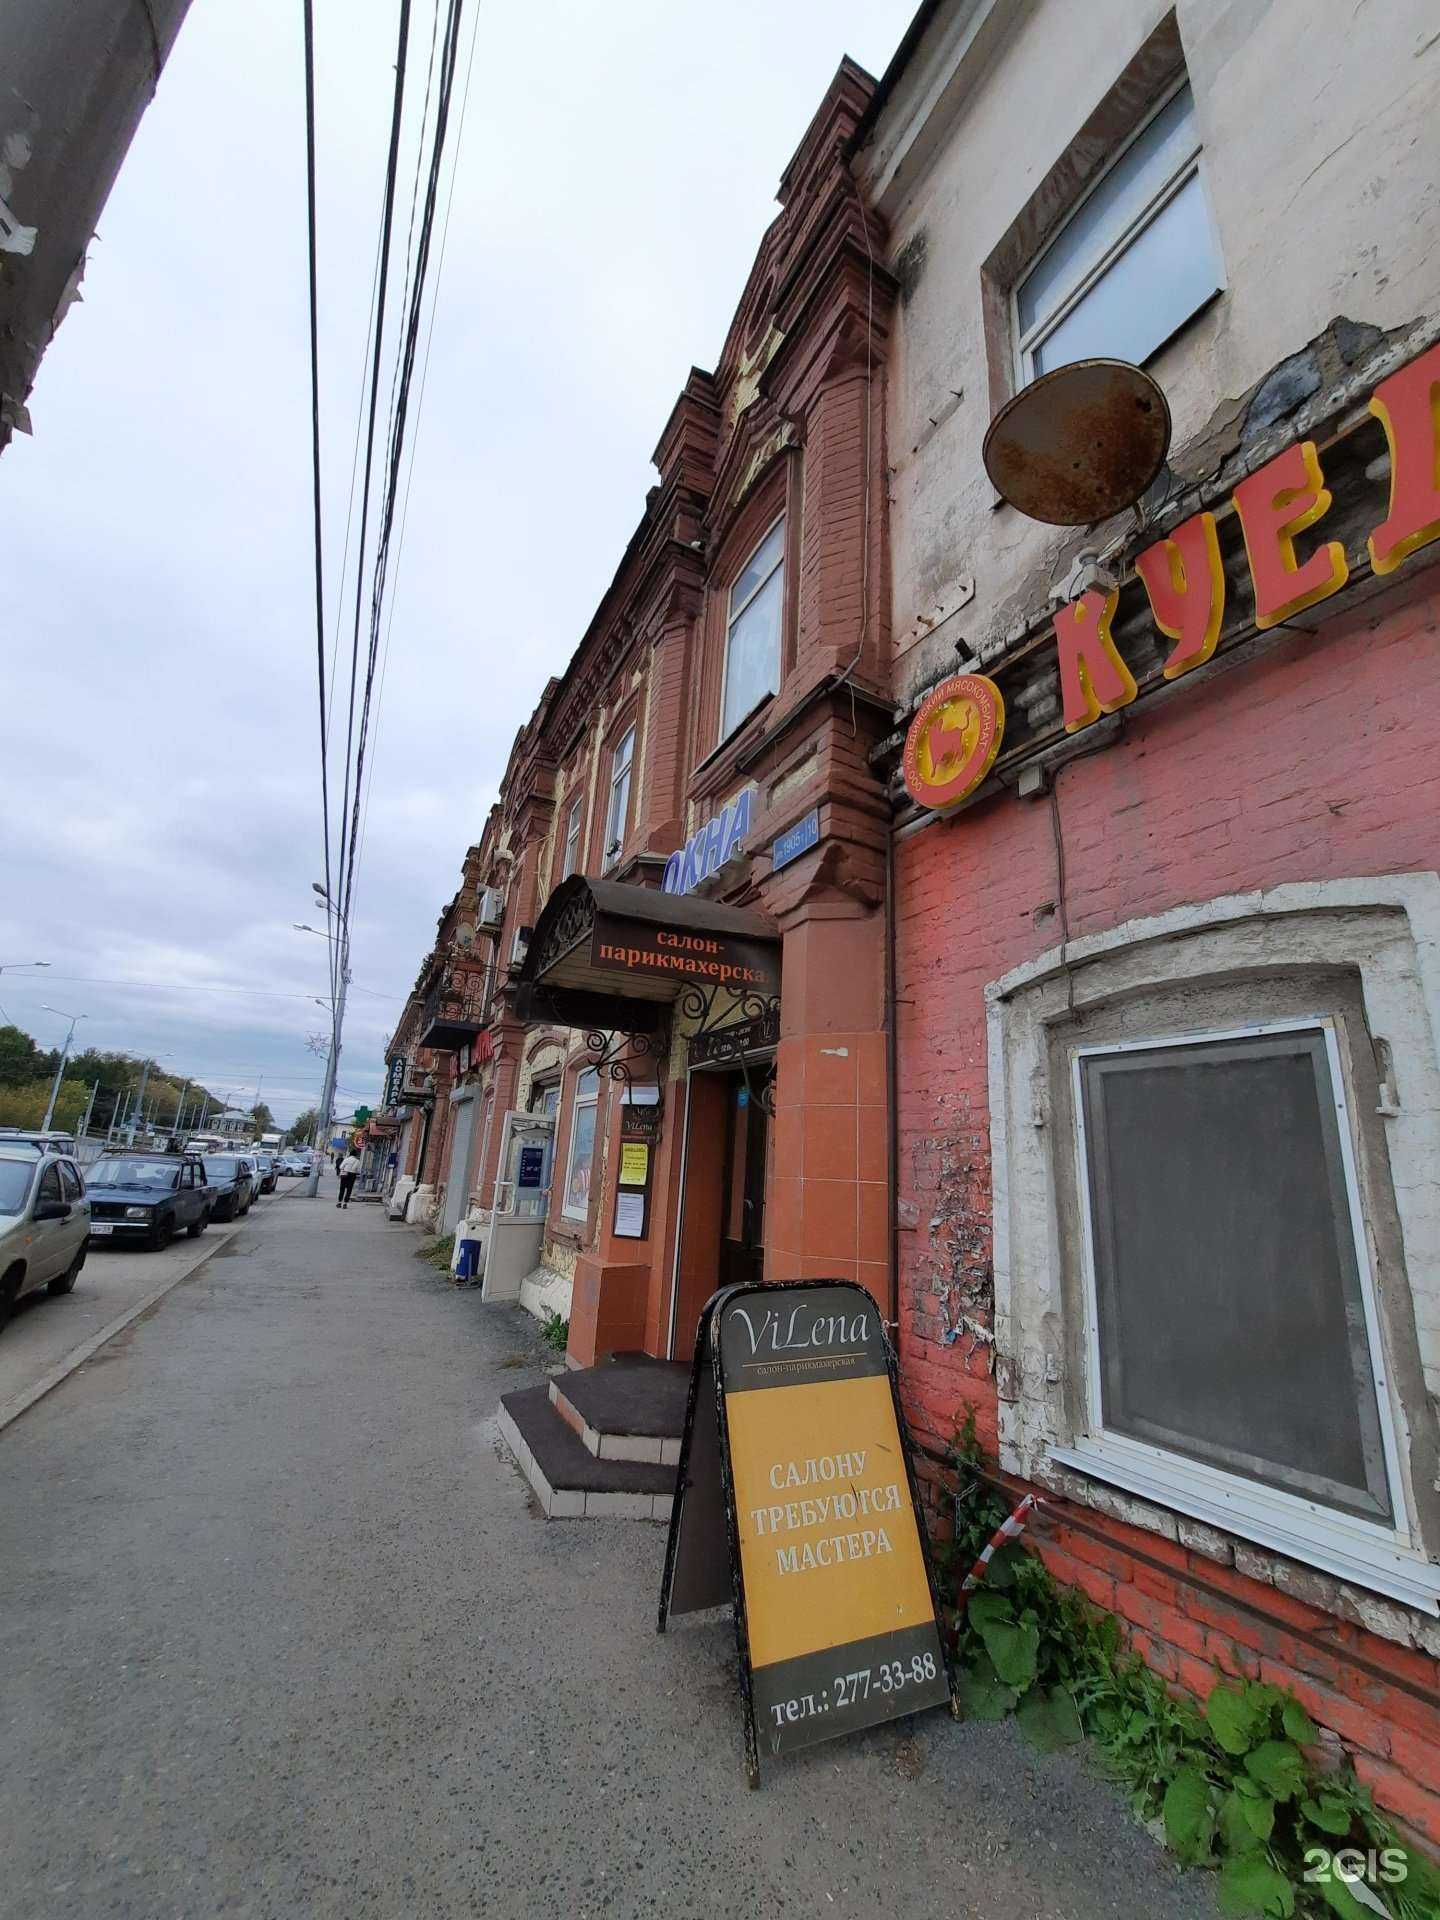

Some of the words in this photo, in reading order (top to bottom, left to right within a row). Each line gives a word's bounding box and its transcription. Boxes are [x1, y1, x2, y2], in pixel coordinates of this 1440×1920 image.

[661, 787, 751, 896] ОКНА
[599, 943, 769, 984] парикмахерска
[656, 931, 725, 954] салон-
[728, 1304, 871, 1355] ViLena
[757, 1357, 856, 1376] салон-парикмахерская
[769, 1450, 866, 1489] САЛОНУ
[751, 1484, 901, 1536] ТРЕБУЮТСЯ
[776, 1527, 892, 1576] МАСТЕРА
[770, 1689, 829, 1726] тел.:
[834, 1651, 937, 1707] 277-33-88
